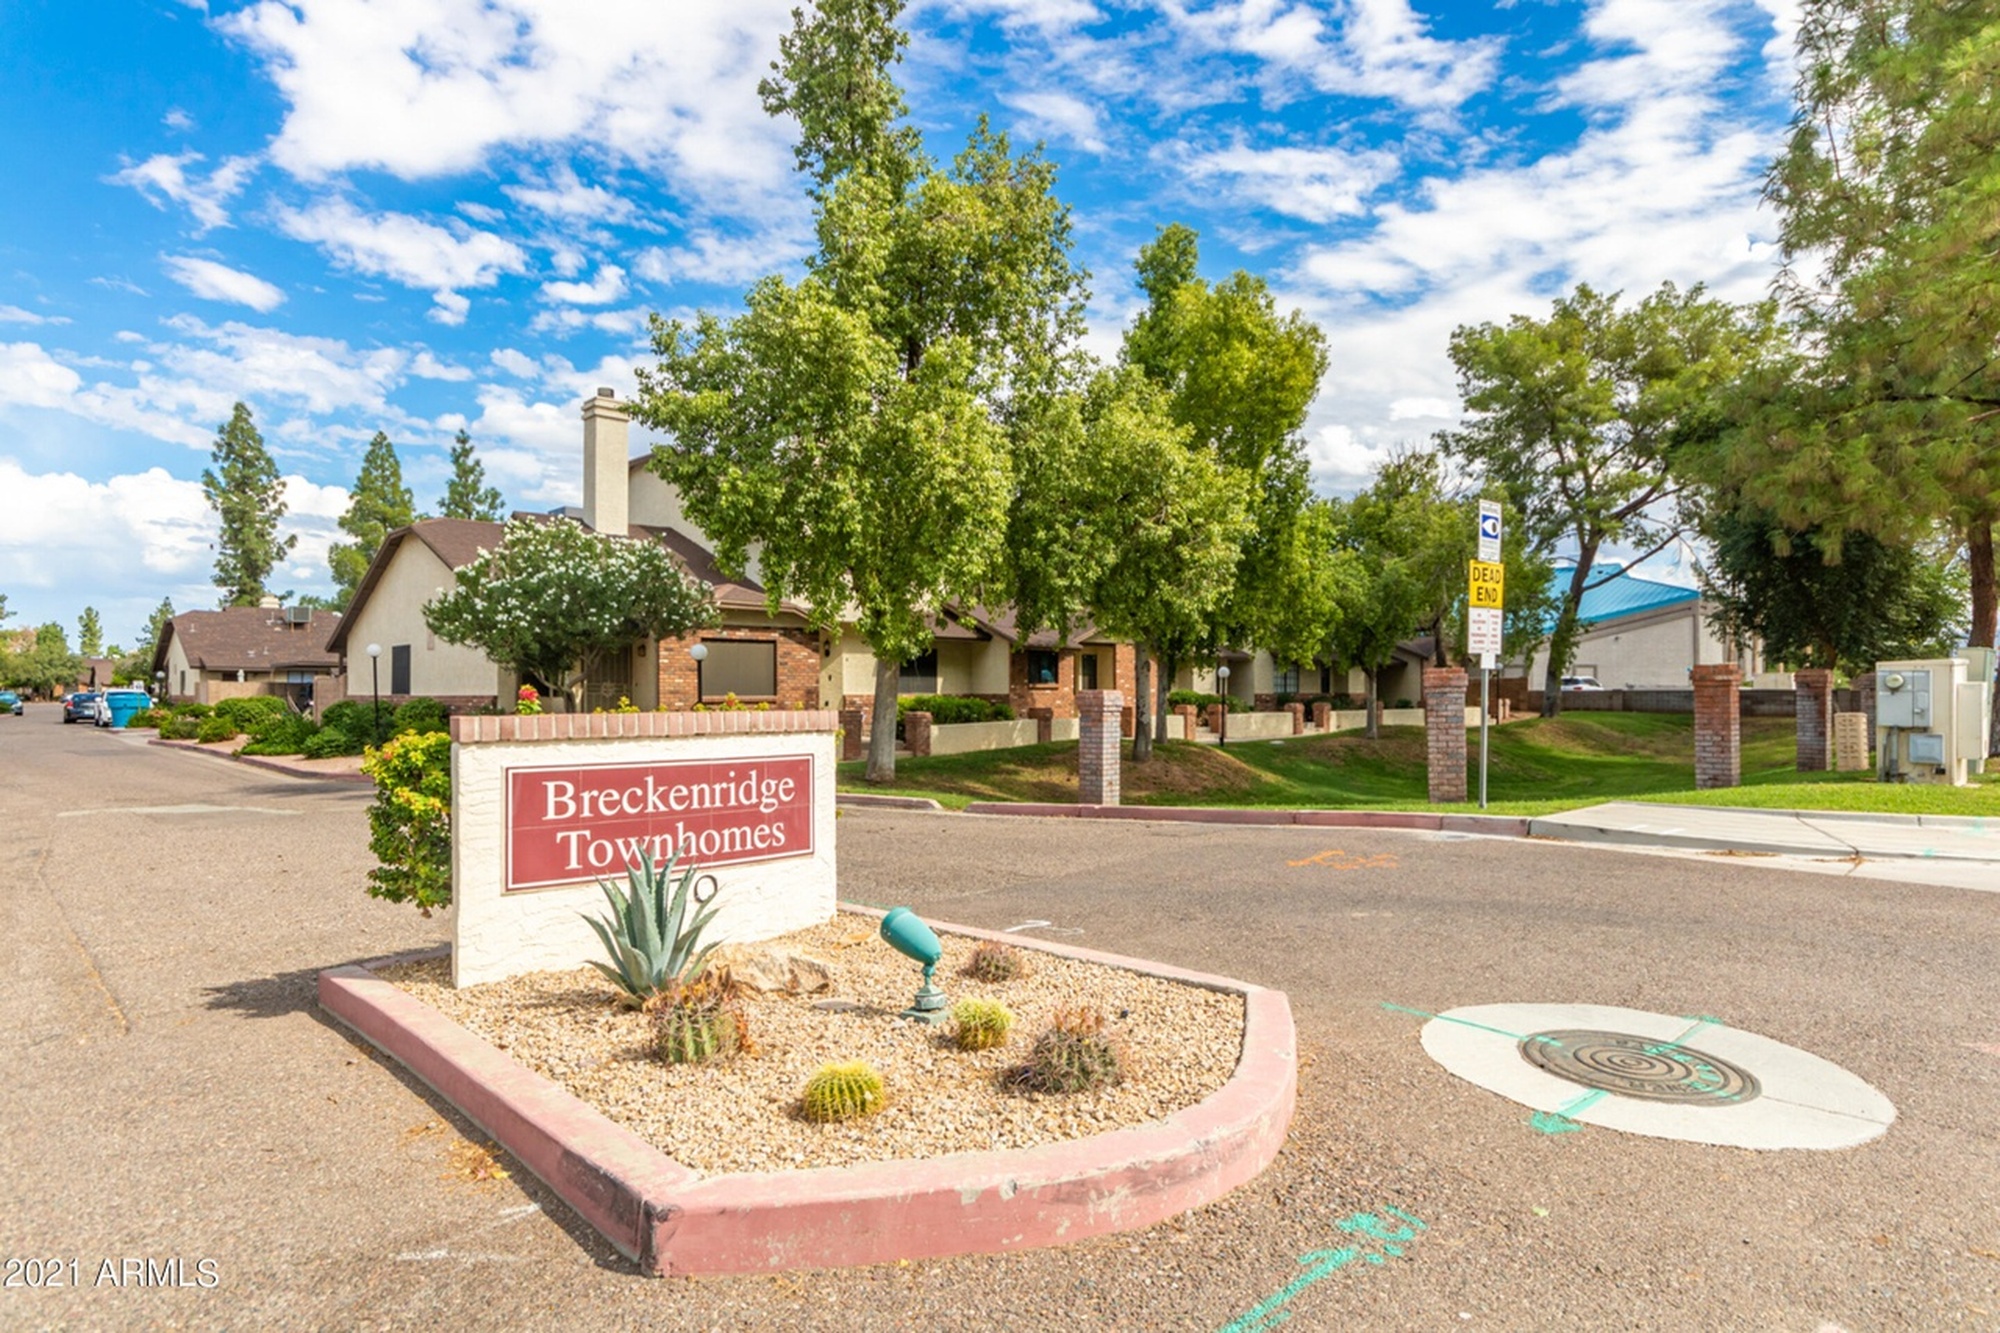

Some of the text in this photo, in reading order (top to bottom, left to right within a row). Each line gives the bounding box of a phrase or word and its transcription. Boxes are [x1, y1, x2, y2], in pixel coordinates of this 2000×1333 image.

[1472, 566, 1501, 585] DEAD
[1476, 586, 1498, 603] END
[541, 769, 796, 820] Breckenridge
[556, 821, 786, 870] Townhomes
